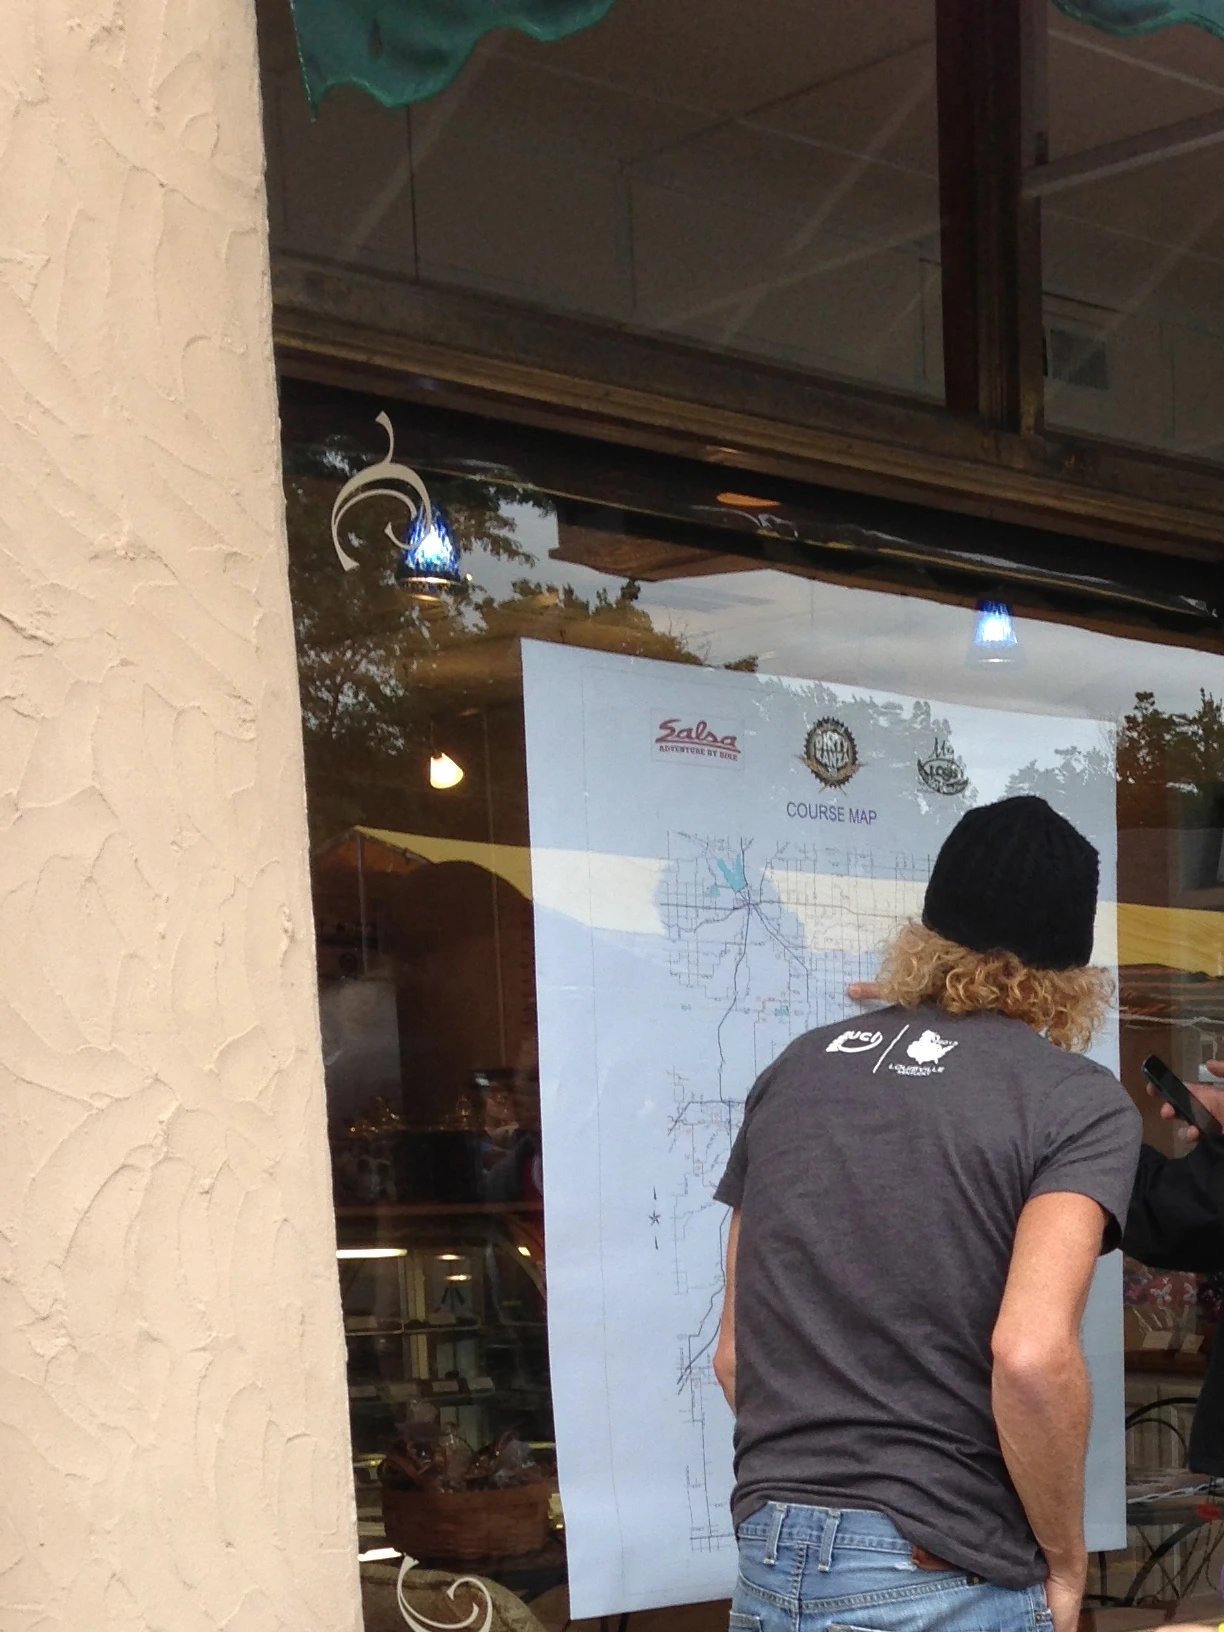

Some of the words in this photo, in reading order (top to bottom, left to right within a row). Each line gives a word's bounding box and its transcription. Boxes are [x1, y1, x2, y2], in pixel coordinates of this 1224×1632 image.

[655, 719, 739, 750] Salsa
[787, 801, 846, 822] COURSE
[848, 807, 877, 825] MAP
